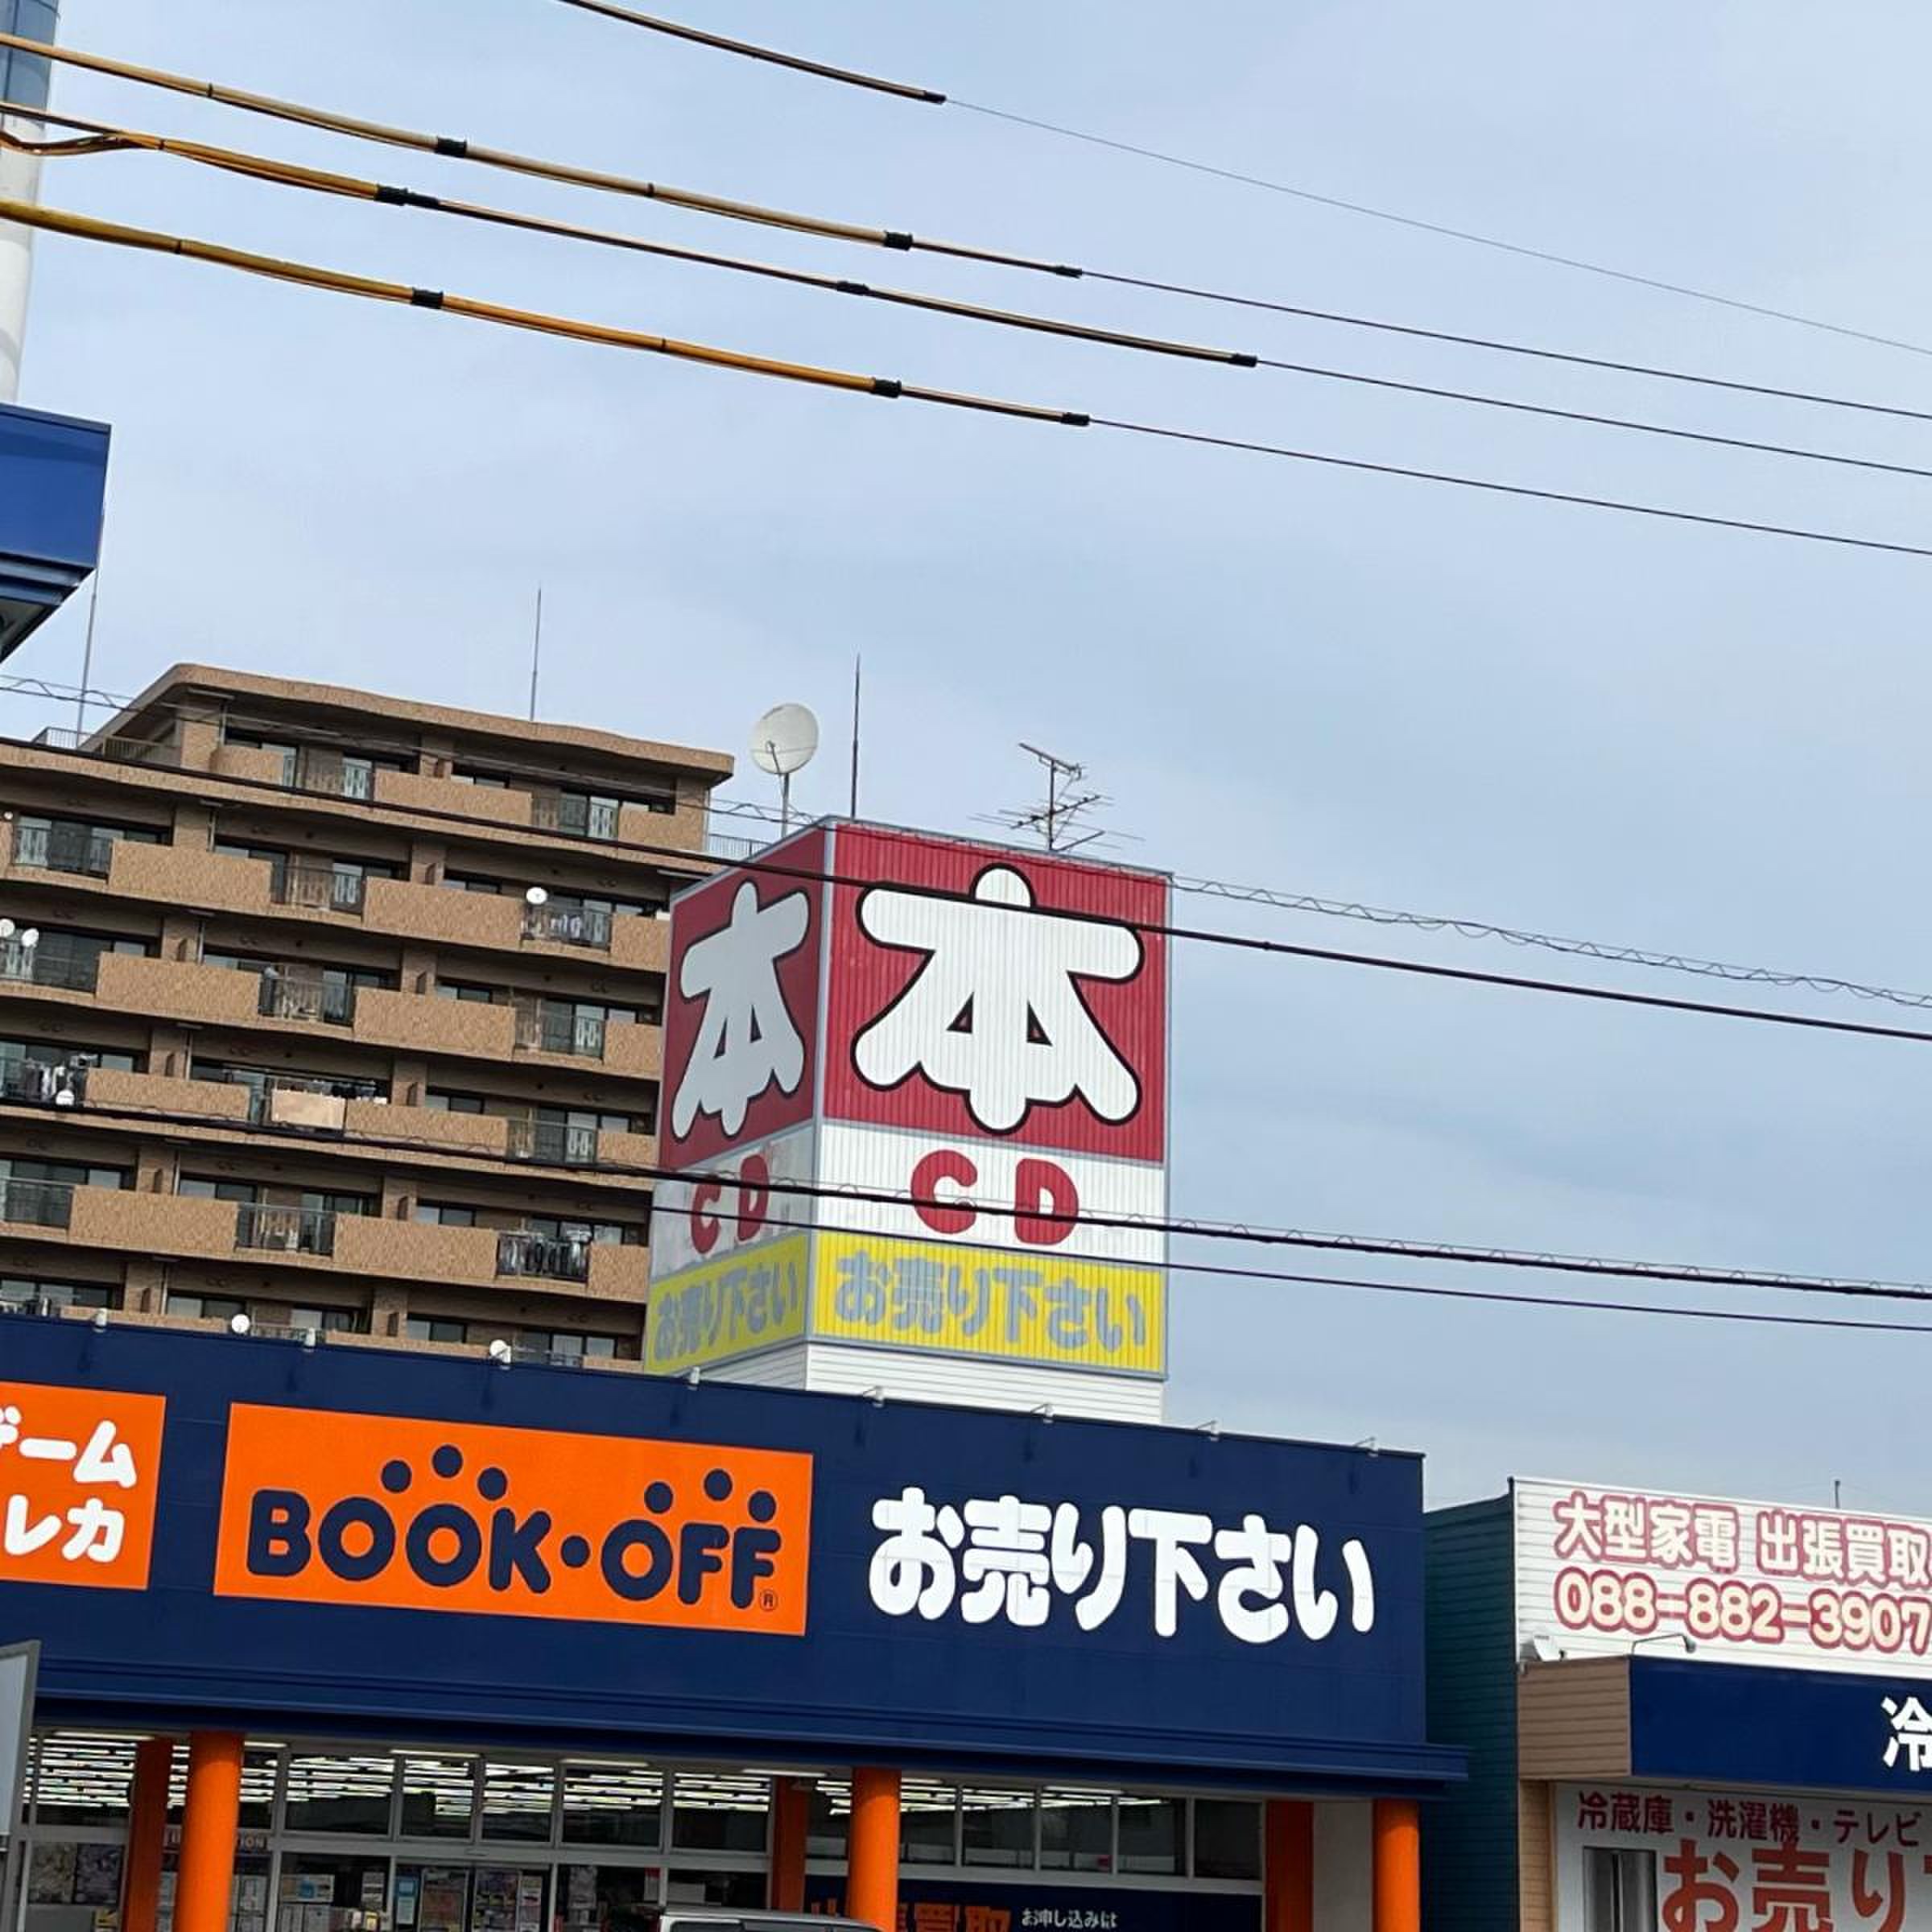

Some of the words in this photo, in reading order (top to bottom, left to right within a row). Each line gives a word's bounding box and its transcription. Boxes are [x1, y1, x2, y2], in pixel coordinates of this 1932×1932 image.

[671, 881, 810, 1142] 本
[849, 862, 1145, 1134] 本
[653, 1261, 799, 1361] お売り下さい
[833, 1250, 1148, 1352] お売り下さい
[869, 1486, 1375, 1644] お売り下さい
[1553, 1491, 1740, 1574] 大型家電
[1756, 1509, 1932, 1589] 出張買取
[1554, 1567, 1932, 1656] 088-882-3907
[1021, 1907, 1118, 1929] お申し込みは
[1662, 1839, 1932, 1932] お売り
